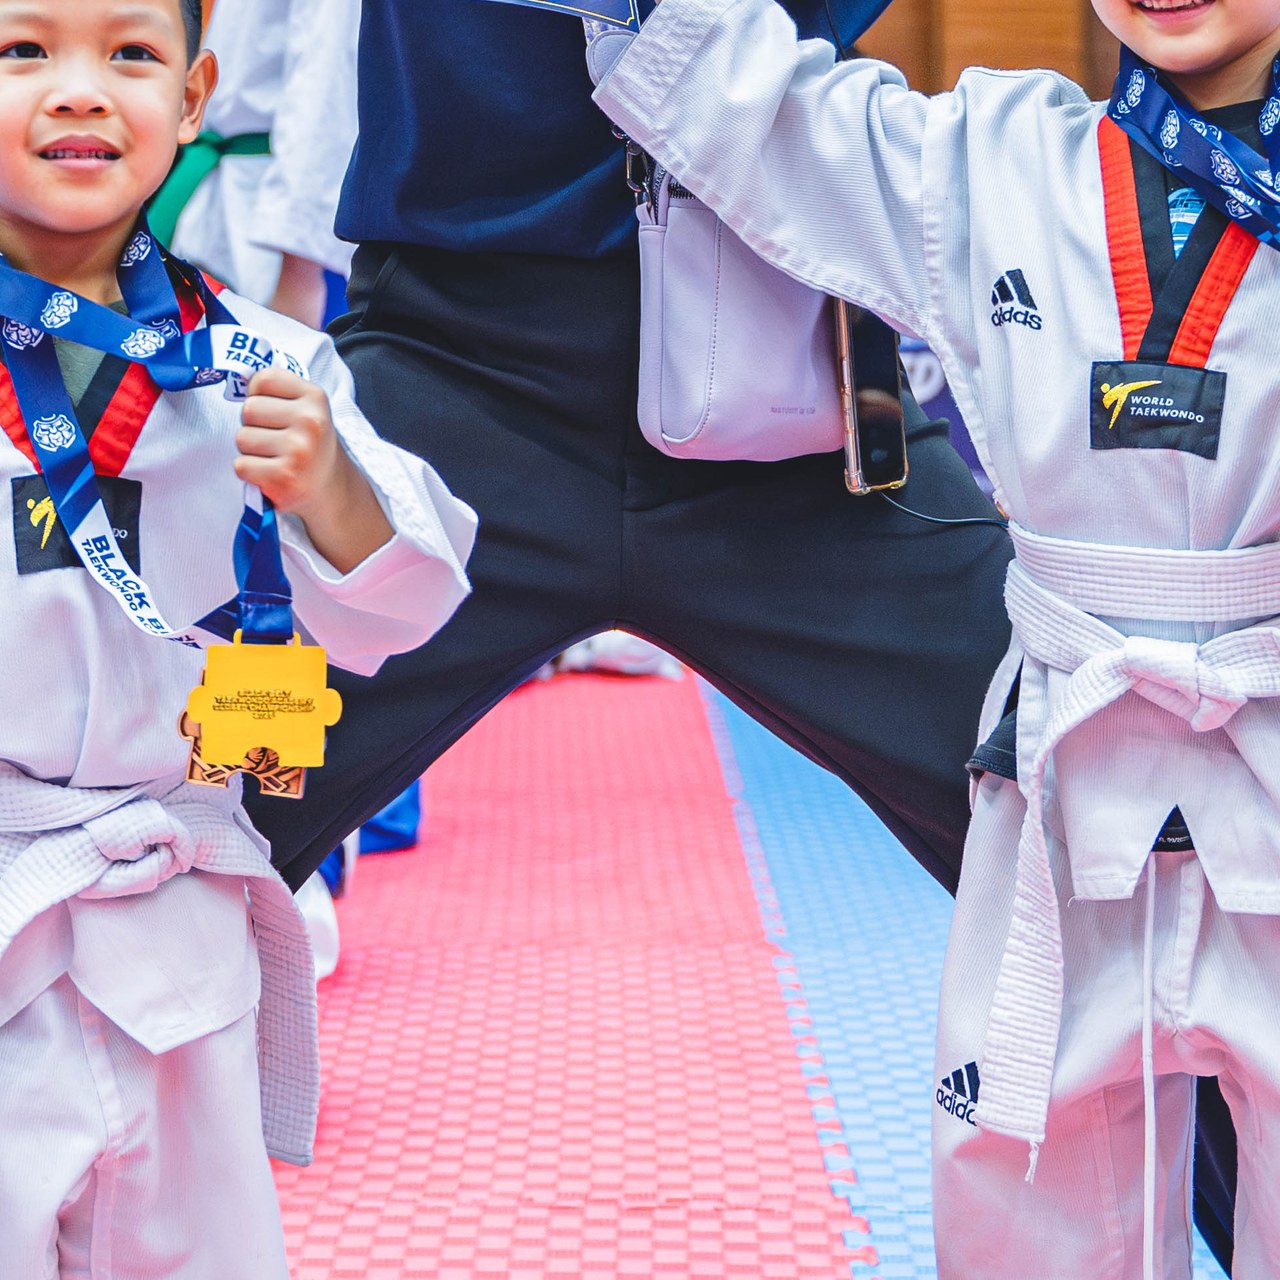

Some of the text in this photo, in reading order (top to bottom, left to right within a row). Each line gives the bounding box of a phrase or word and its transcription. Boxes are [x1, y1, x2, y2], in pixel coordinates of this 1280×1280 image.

[991, 306, 1042, 330] adas
[229, 331, 273, 366] BLA
[226, 350, 267, 372] TAEK
[1131, 395, 1174, 407] WORLD
[1130, 407, 1205, 423] TAEKWONDO
[81, 538, 138, 611] TAEKWONDO
[91, 534, 151, 609] BLACK
